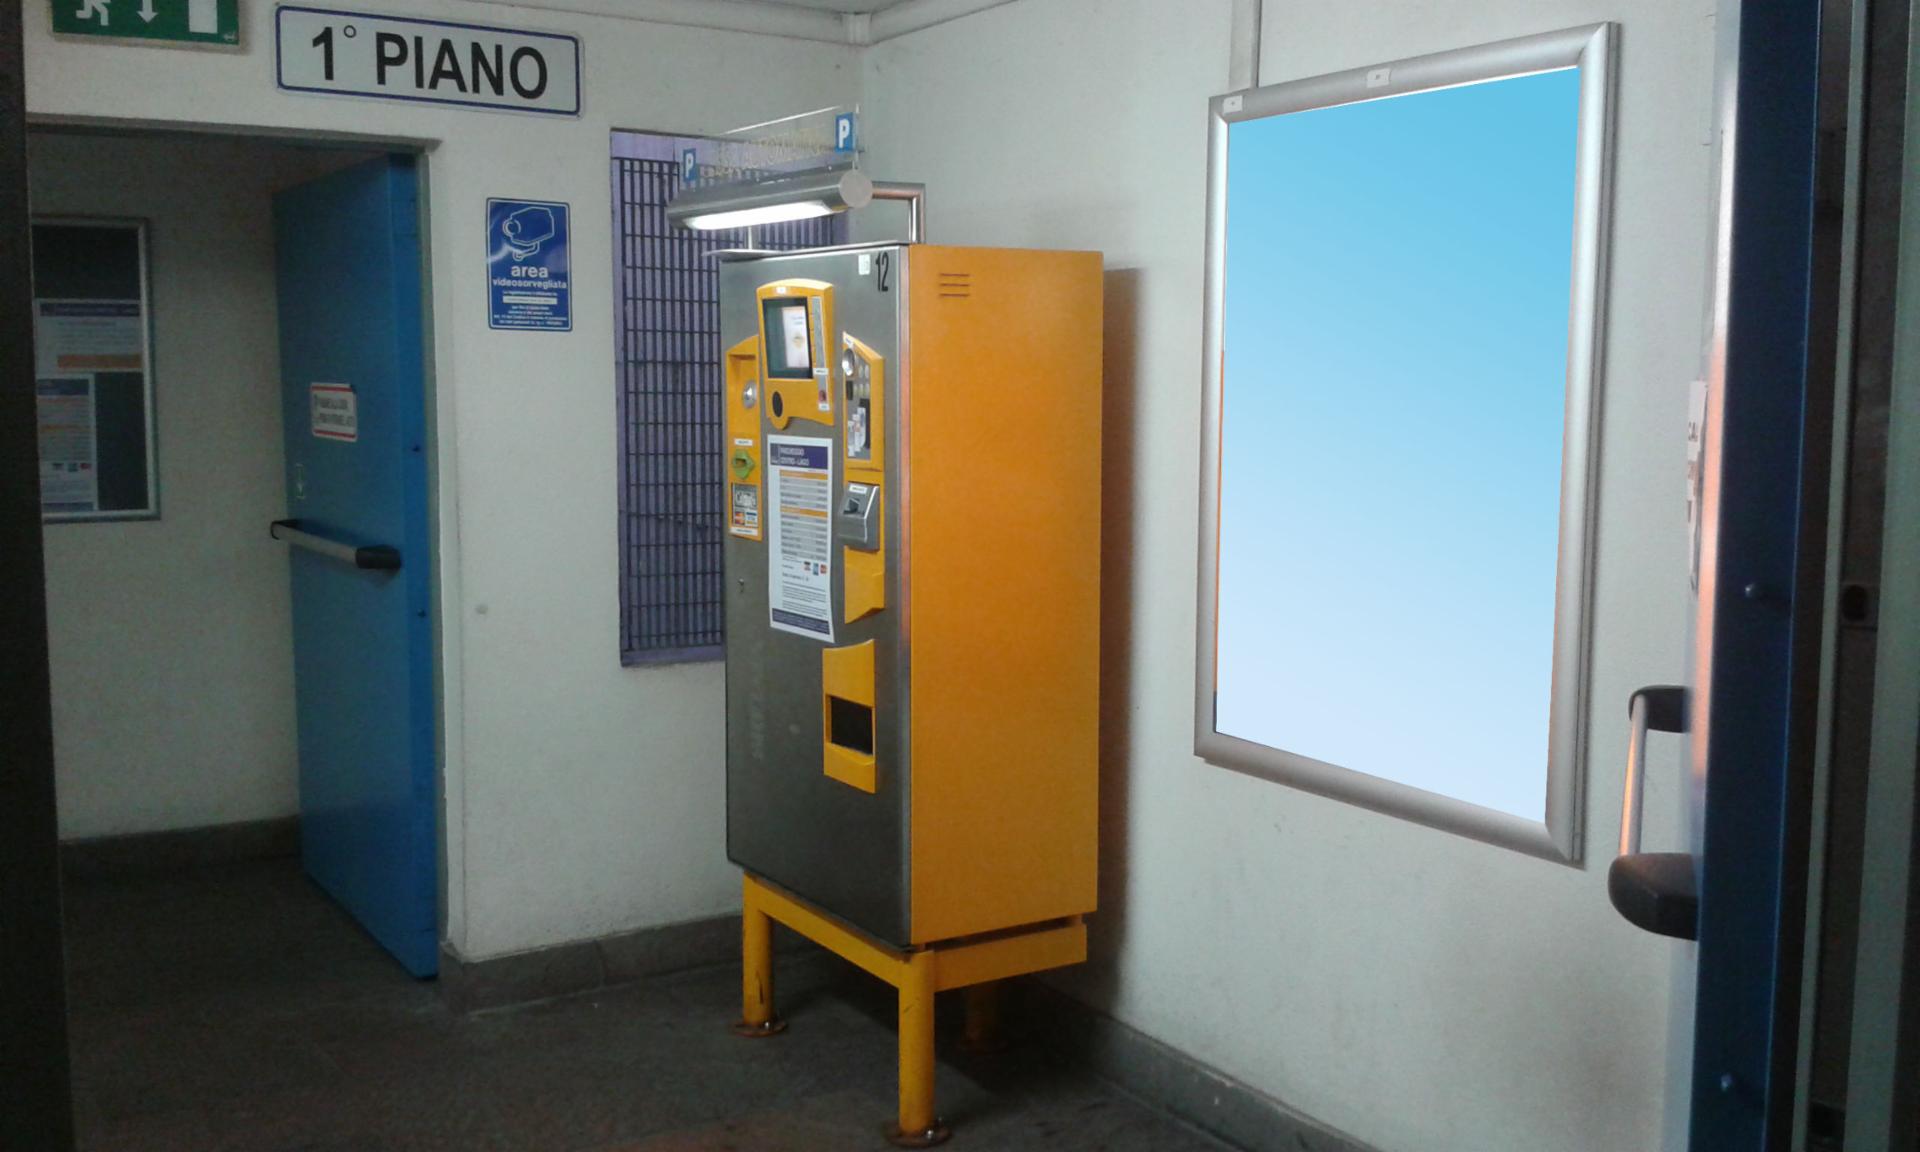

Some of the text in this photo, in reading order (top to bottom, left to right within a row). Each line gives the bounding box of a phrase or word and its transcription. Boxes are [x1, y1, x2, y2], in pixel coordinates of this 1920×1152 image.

[375, 31, 548, 99] PIANO
[838, 118, 850, 149] P
[685, 152, 693, 175] P
[492, 277, 568, 289] videosorvegliata
[510, 265, 549, 278] area
[875, 251, 889, 291] 12
